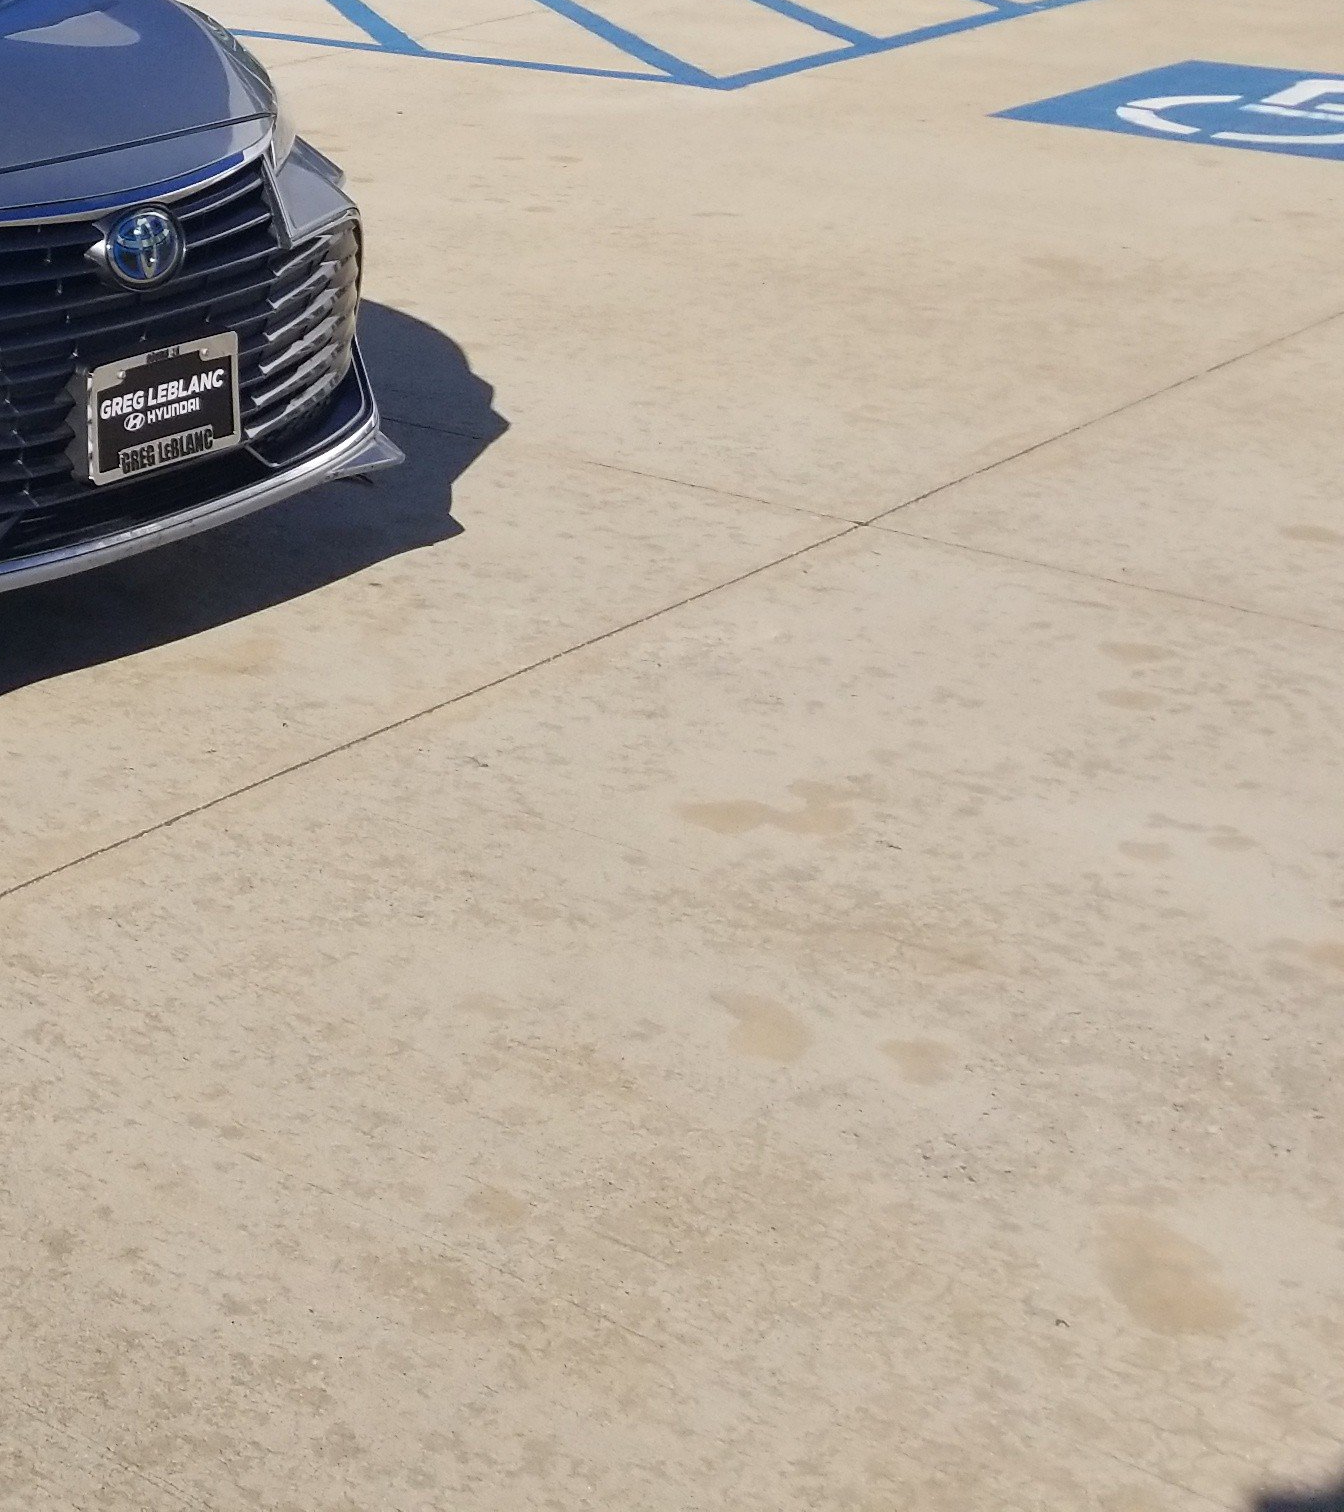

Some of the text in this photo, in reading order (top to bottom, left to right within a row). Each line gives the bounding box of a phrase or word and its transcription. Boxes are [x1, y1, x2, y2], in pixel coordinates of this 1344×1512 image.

[100, 368, 225, 420] GREG LEBLANC
[147, 397, 200, 424] HYUNDAI
[122, 444, 156, 475] GREG
